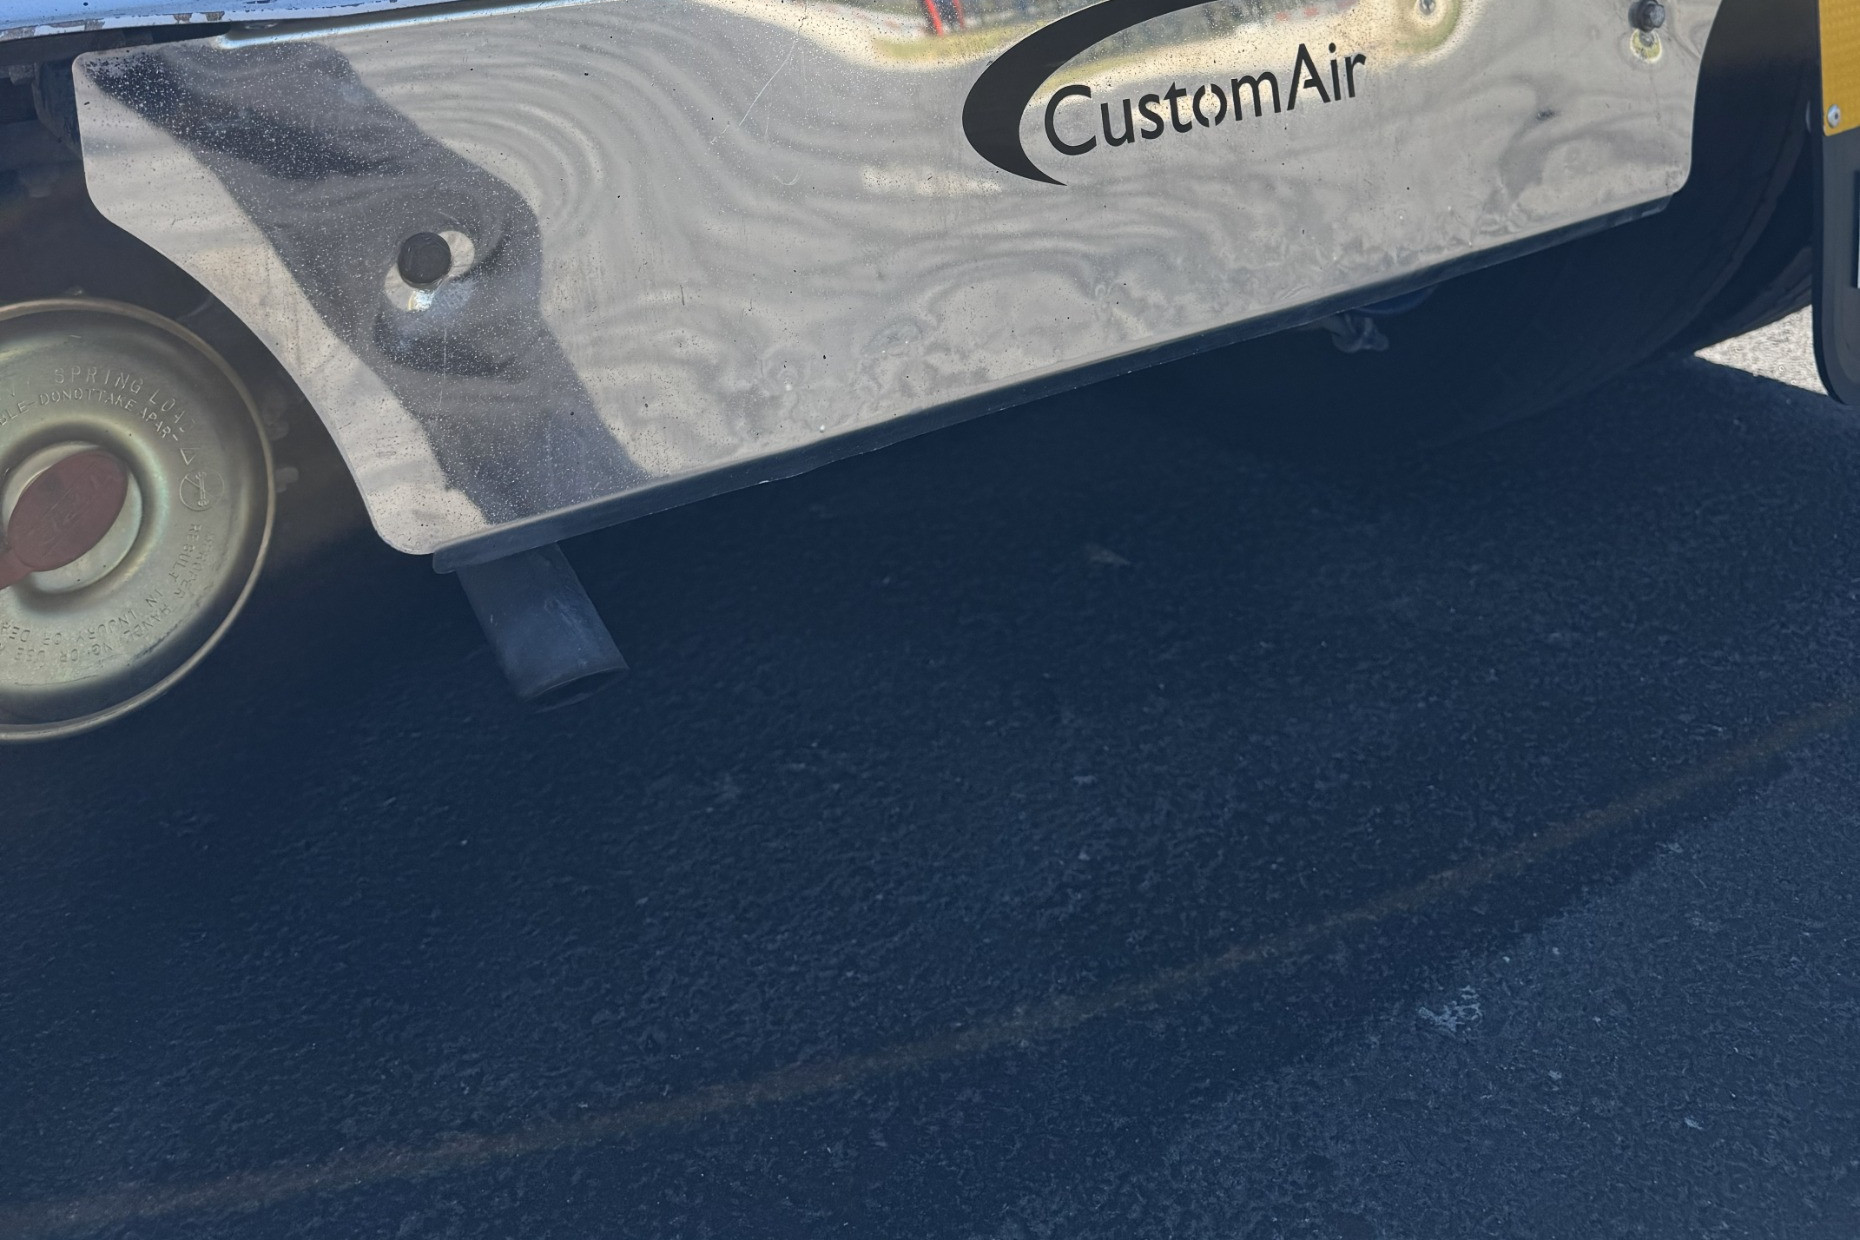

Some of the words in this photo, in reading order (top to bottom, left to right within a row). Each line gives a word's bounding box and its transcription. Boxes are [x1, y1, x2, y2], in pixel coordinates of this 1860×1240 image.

[1043, 42, 1367, 156] CustomAir
[54, 364, 144, 394] SPRING
[168, 523, 201, 583] RESULT
[145, 588, 164, 608] IN
[91, 603, 172, 657] HANDLNG
